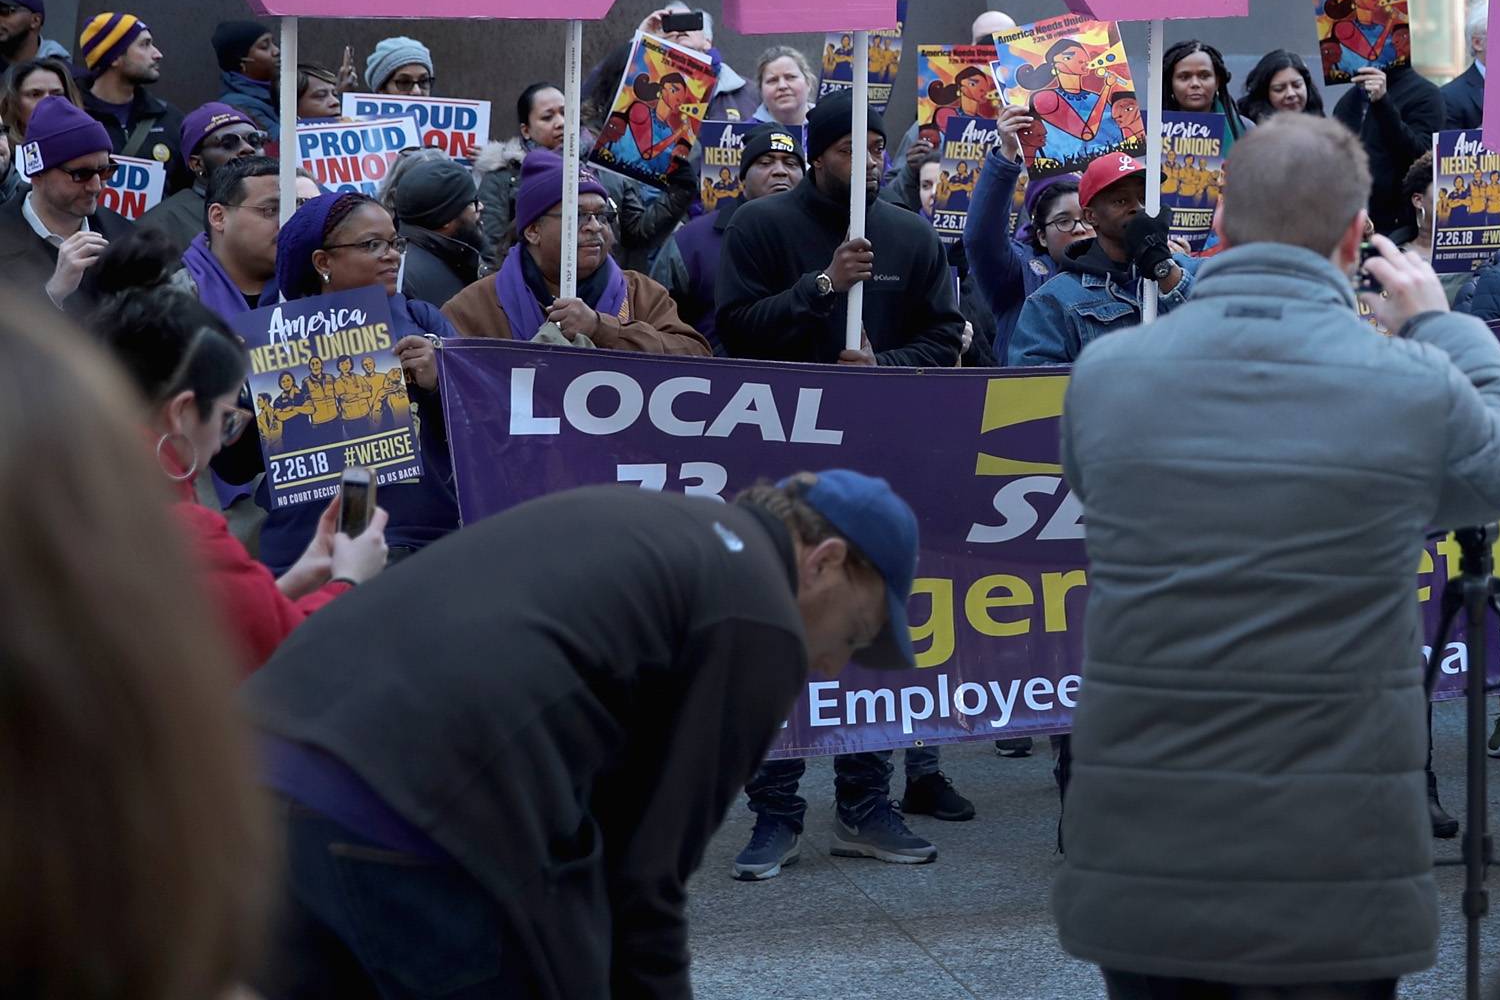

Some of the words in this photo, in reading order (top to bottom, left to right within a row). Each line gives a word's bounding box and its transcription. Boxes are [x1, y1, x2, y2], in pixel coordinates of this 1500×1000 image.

[998, 29, 1035, 44] America
[300, 126, 407, 159] PROUD
[961, 119, 1003, 152] Amer
[1161, 121, 1211, 139] merica
[945, 140, 985, 161] NEEDS
[1174, 138, 1221, 157] UNIONS
[1440, 156, 1480, 176] NEEDS
[1172, 212, 1212, 227] #WERISE
[1436, 231, 1473, 246] 2.26.18
[267, 306, 367, 354] America
[250, 337, 313, 375] NEEDS
[316, 322, 392, 361] UNIONS
[509, 367, 844, 445] LOCAL
[270, 452, 329, 483] 2.26.18
[344, 433, 414, 468] #WERISE
[277, 495, 289, 506] NO
[289, 490, 312, 505] COURT
[313, 484, 341, 500] DECISIO
[376, 475, 386, 485] LD
[386, 472, 398, 482] US
[399, 465, 421, 480] BACK!
[908, 569, 1088, 668] ger
[808, 673, 1083, 734] Employee
